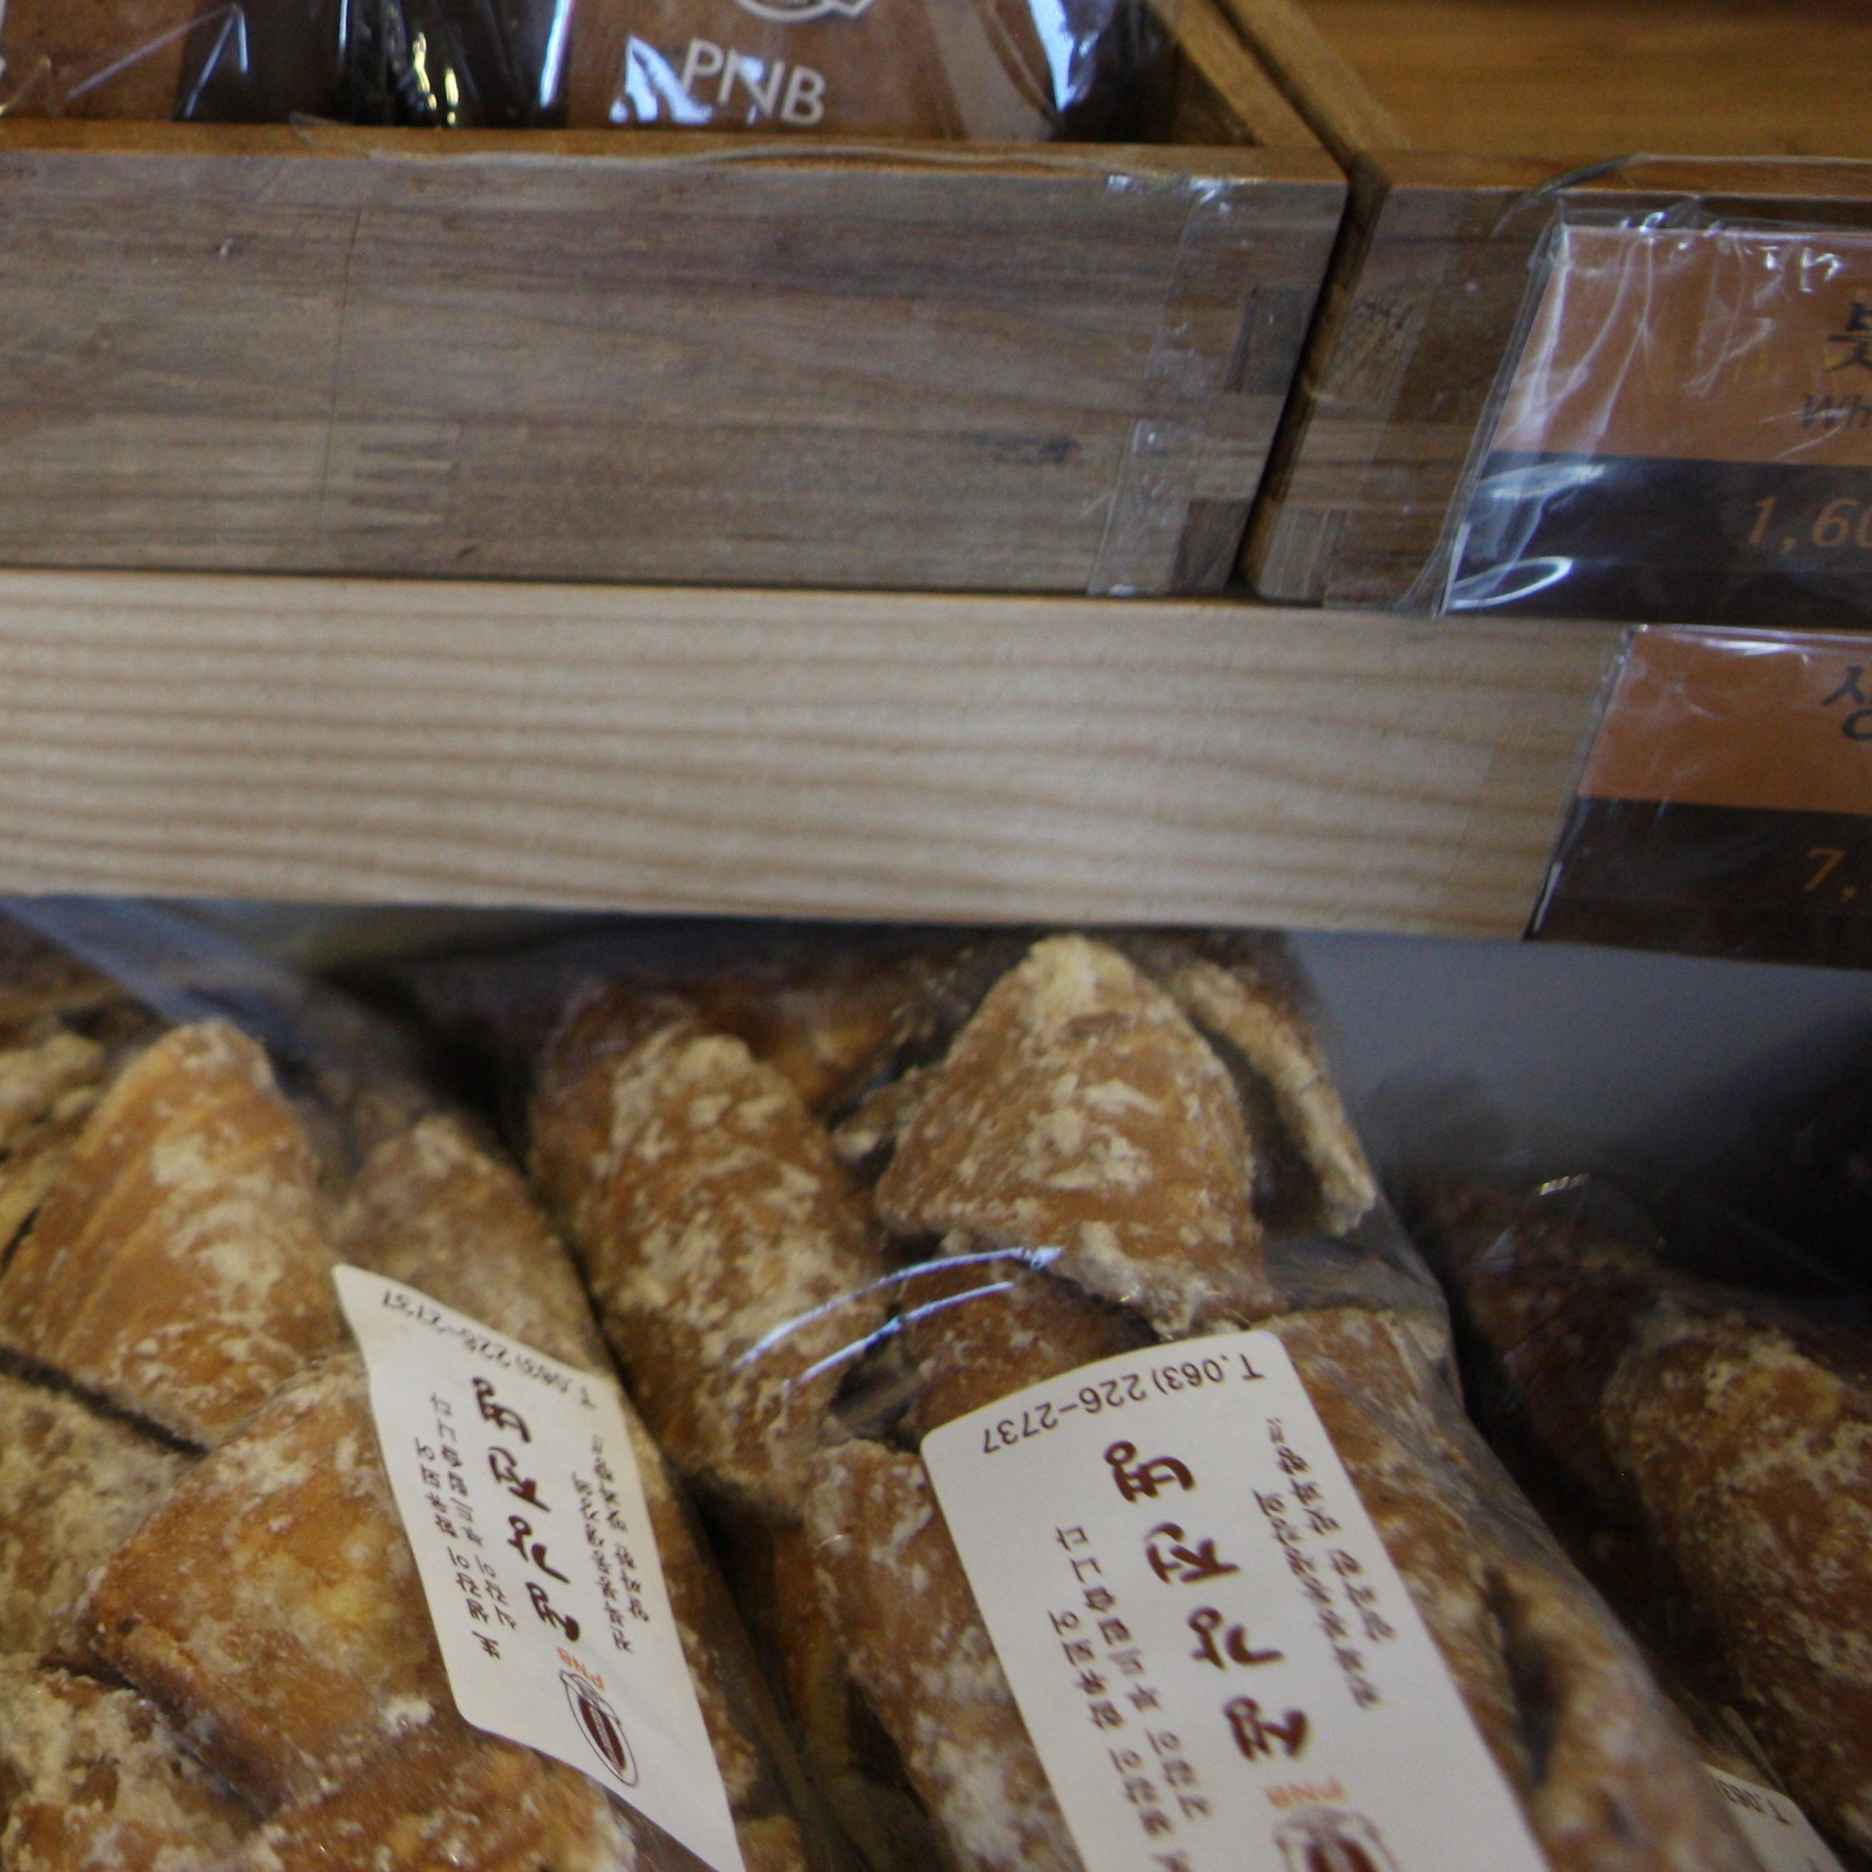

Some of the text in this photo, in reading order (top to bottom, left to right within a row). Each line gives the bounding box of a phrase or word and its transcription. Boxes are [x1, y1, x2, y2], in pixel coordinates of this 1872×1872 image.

[682, 37, 826, 126] PNB
[981, 1352, 1265, 1454] T.063) 226-2737
[472, 1376, 580, 1642] 생강전병
[1103, 1439, 1310, 1762] 생강전병
